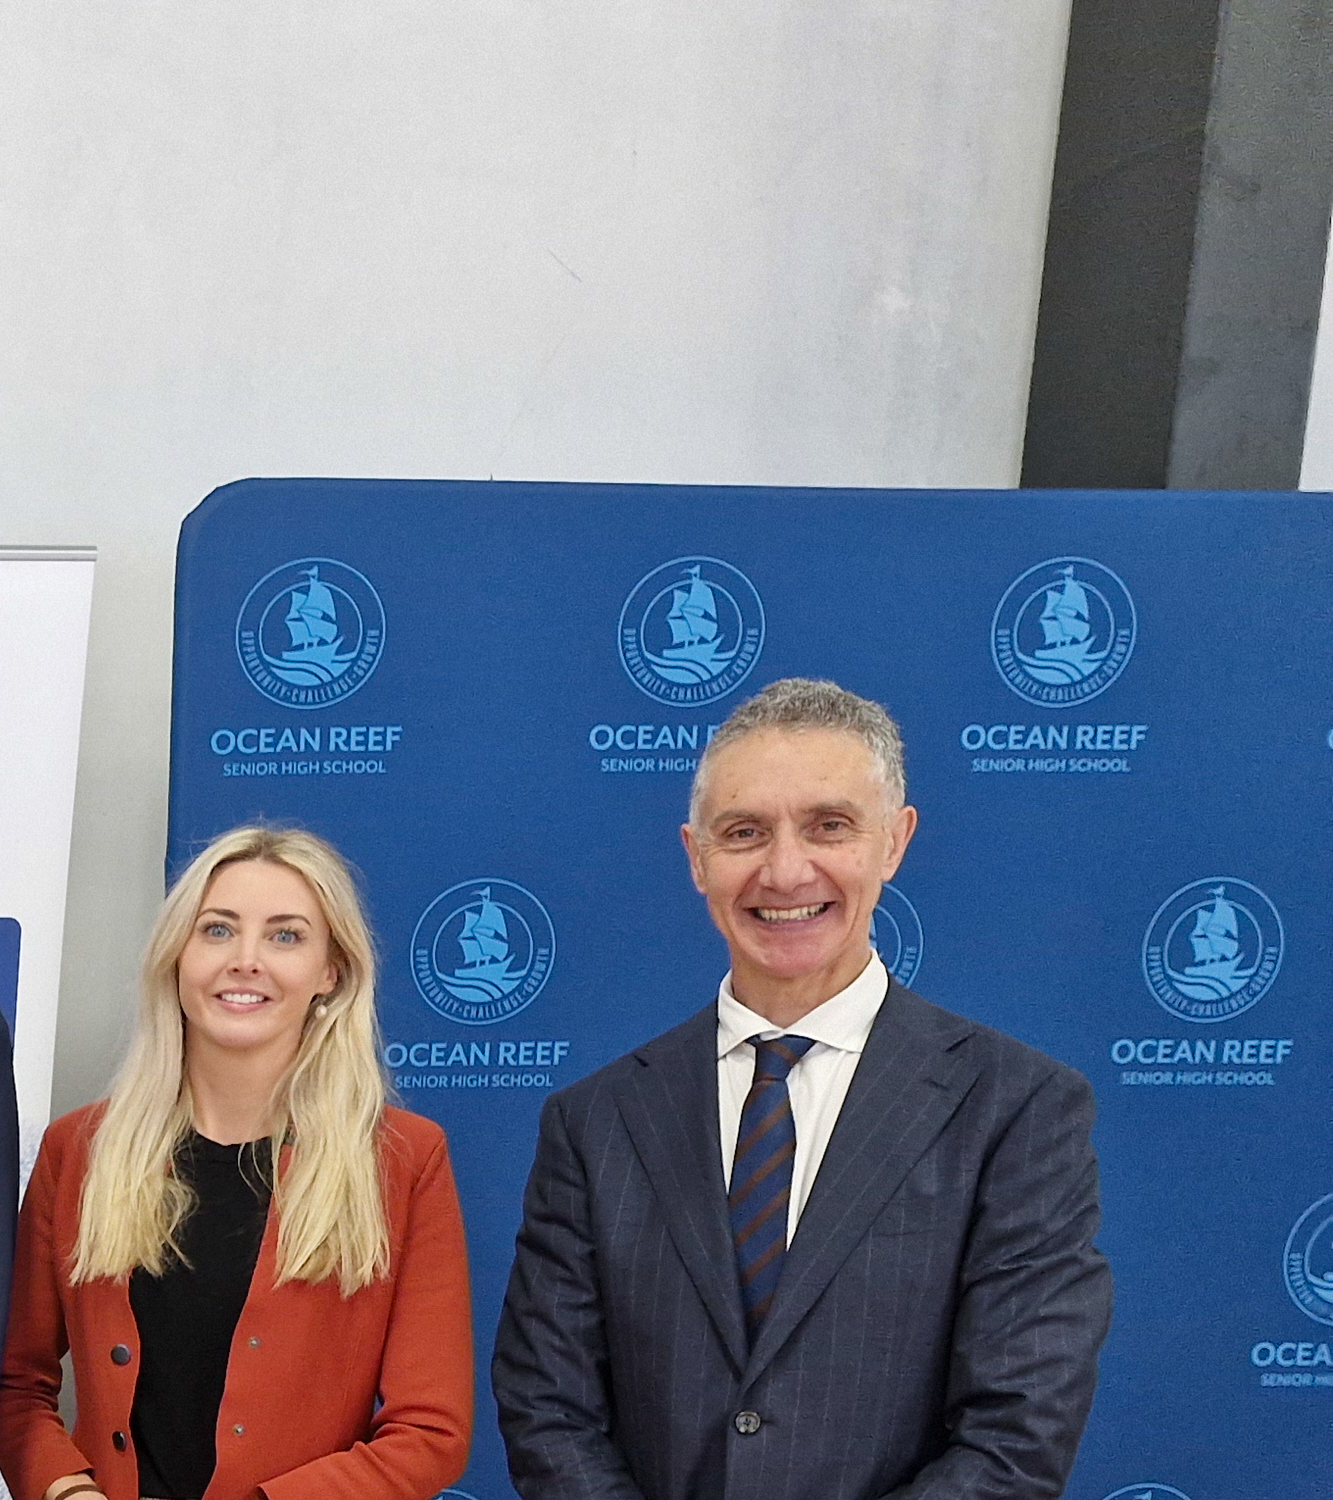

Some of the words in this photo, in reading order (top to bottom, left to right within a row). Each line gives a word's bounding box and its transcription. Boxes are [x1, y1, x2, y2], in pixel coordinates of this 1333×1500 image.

[211, 727, 320, 754] OCEAN
[329, 726, 402, 751] REEF
[590, 725, 698, 750] OCEAN
[962, 725, 1068, 750] OCEAN
[1075, 725, 1148, 750] REEF
[224, 762, 278, 776] SENIOR
[282, 761, 321, 774] HIGH
[324, 760, 386, 773] SCHOOL
[601, 758, 654, 772] SENIOR
[659, 758, 697, 772] HIGH
[971, 758, 1027, 771] SENIOR
[1028, 758, 1066, 772] HIGH
[1069, 758, 1130, 772] SCHOOL
[384, 1042, 490, 1068] OCEAN
[497, 1042, 569, 1065] REEF
[1112, 1039, 1216, 1064] OCEAN
[1222, 1039, 1293, 1064] REEF
[395, 1075, 448, 1088] SENIOR
[452, 1075, 488, 1087] HIGH
[492, 1074, 553, 1087] SCHOOL
[1251, 1342, 1333, 1367] OCEA
